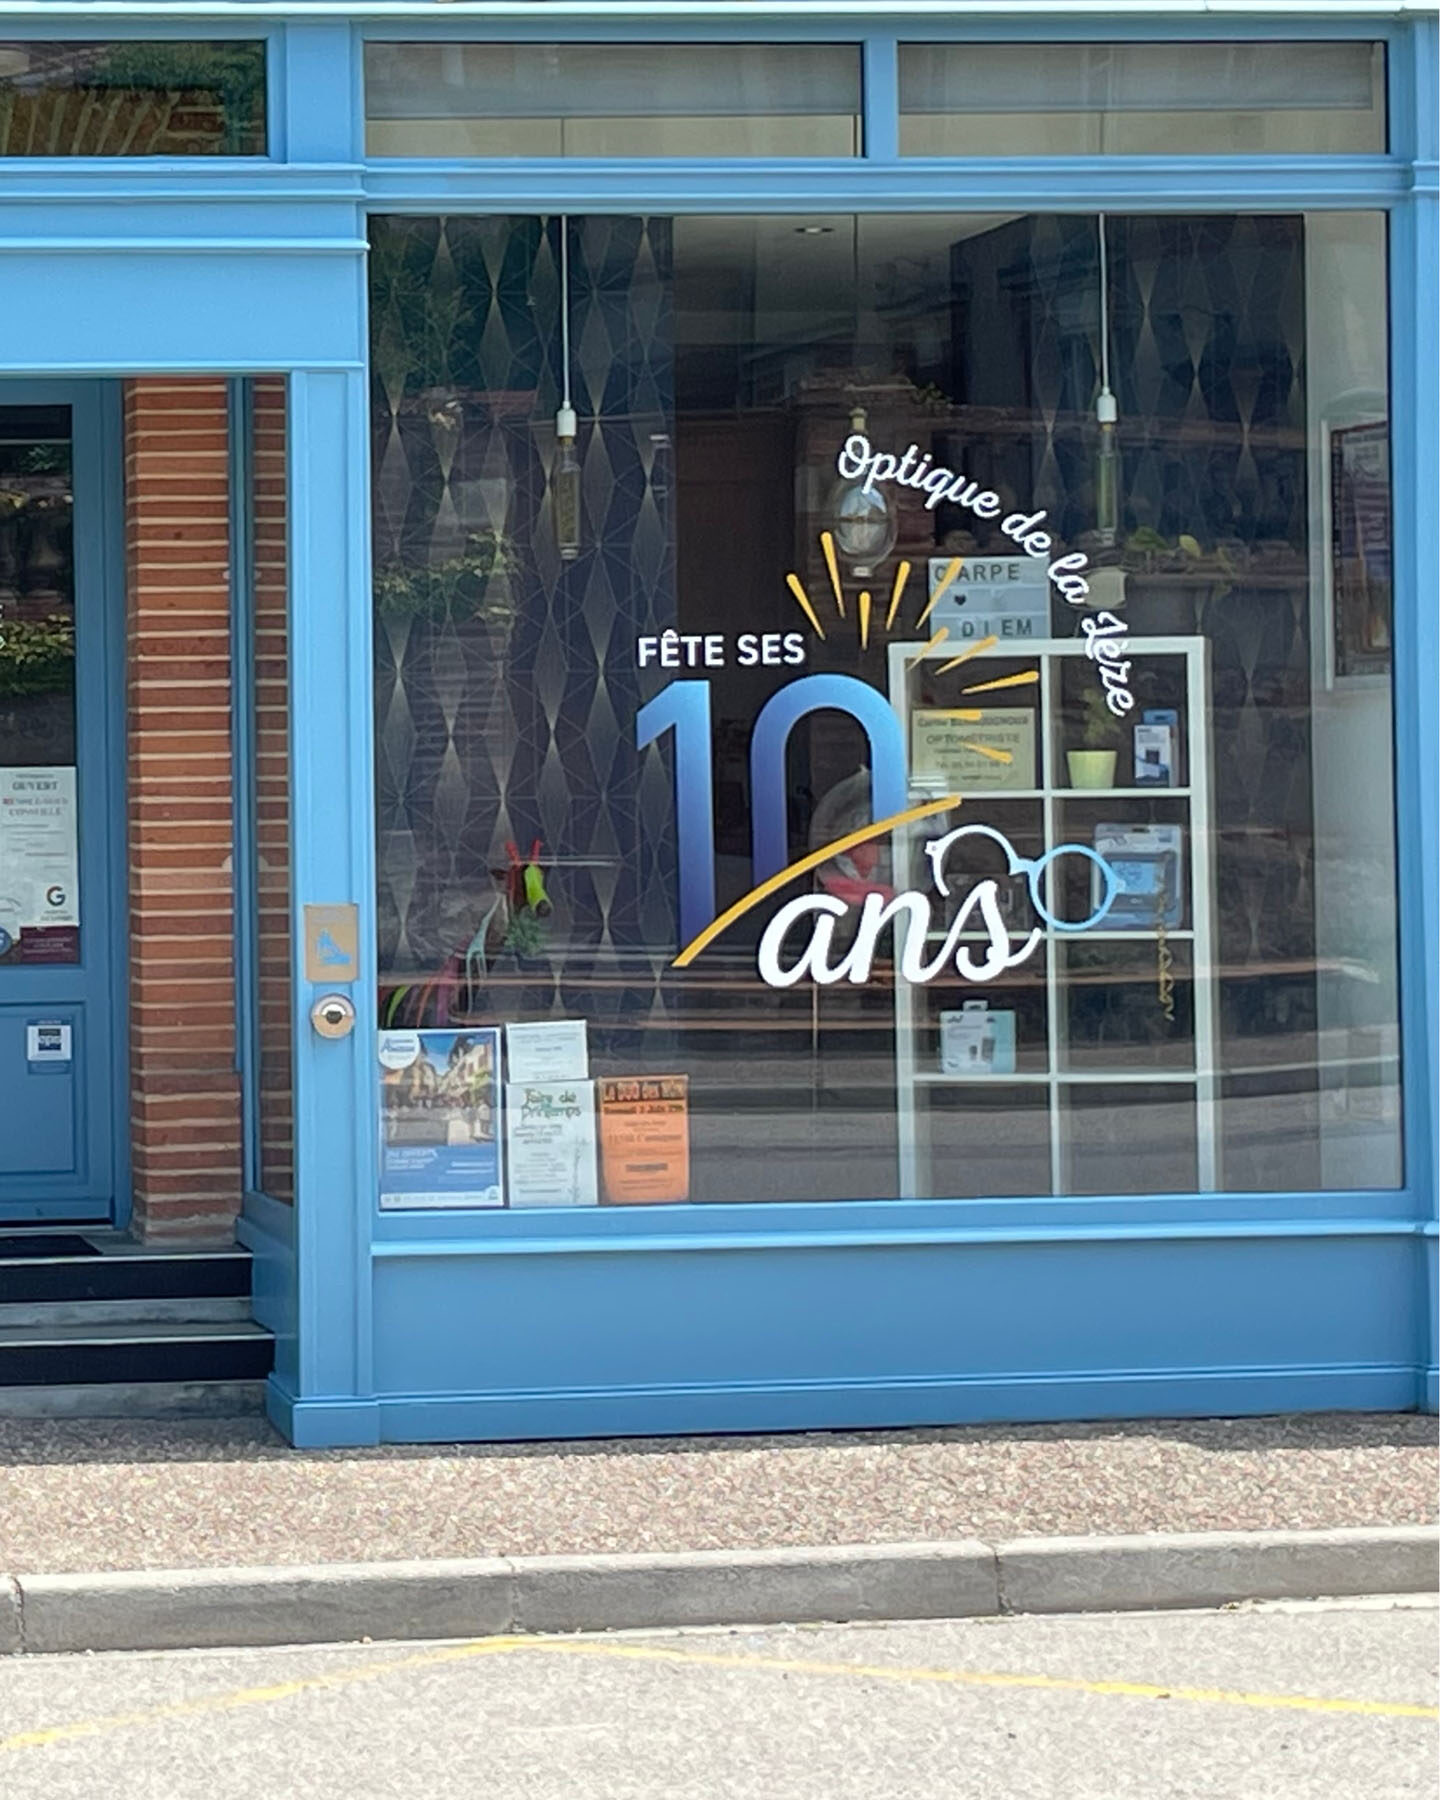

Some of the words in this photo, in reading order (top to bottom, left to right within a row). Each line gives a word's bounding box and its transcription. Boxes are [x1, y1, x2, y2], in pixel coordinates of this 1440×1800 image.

[838, 434, 1000, 518] Optique
[1000, 509, 1052, 558] de
[1047, 552, 1091, 605] la
[934, 563, 1021, 582] CARPE
[637, 628, 725, 668] FÊTE
[737, 632, 806, 667] SES
[636, 673, 908, 950] 10
[46, 886, 66, 906] G
[757, 879, 1043, 989] ans
